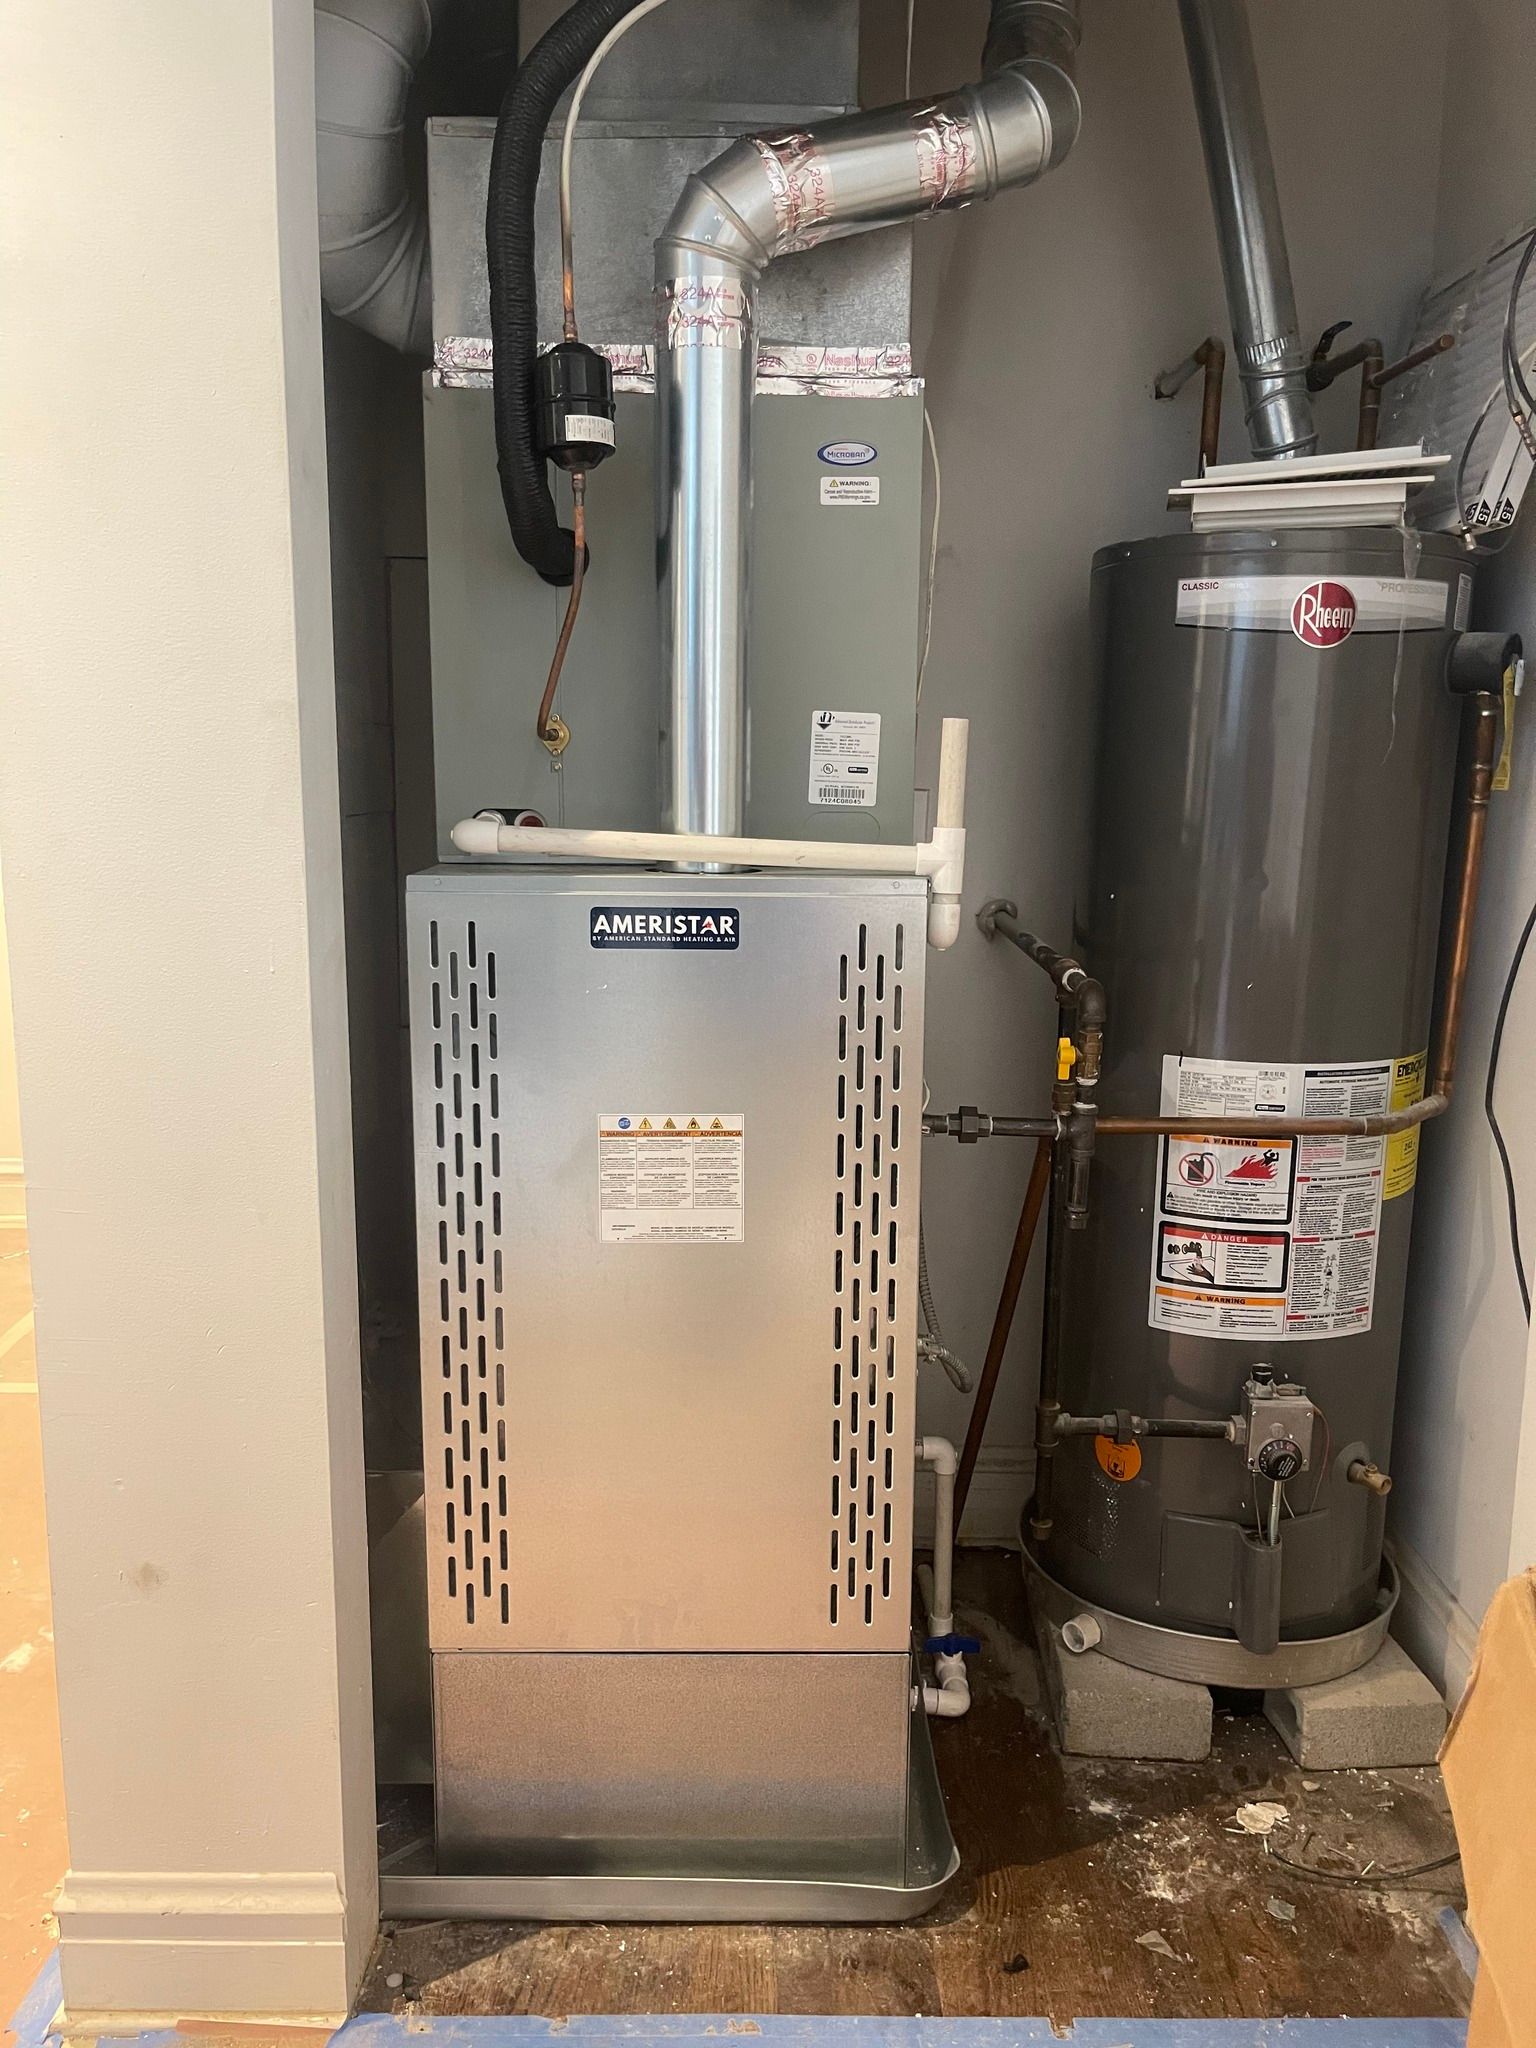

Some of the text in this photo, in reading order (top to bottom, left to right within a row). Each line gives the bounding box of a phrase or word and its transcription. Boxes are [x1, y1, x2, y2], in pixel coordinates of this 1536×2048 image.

[824, 353, 877, 367] Nashua
[1181, 582, 1219, 591] CLASSIC
[1299, 583, 1353, 638] Rheem
[593, 915, 735, 935] AMERISTAR
[1213, 1138, 1258, 1147] WARNING
[1211, 1234, 1248, 1243] DANGER
[1206, 1296, 1246, 1305] WARNING
